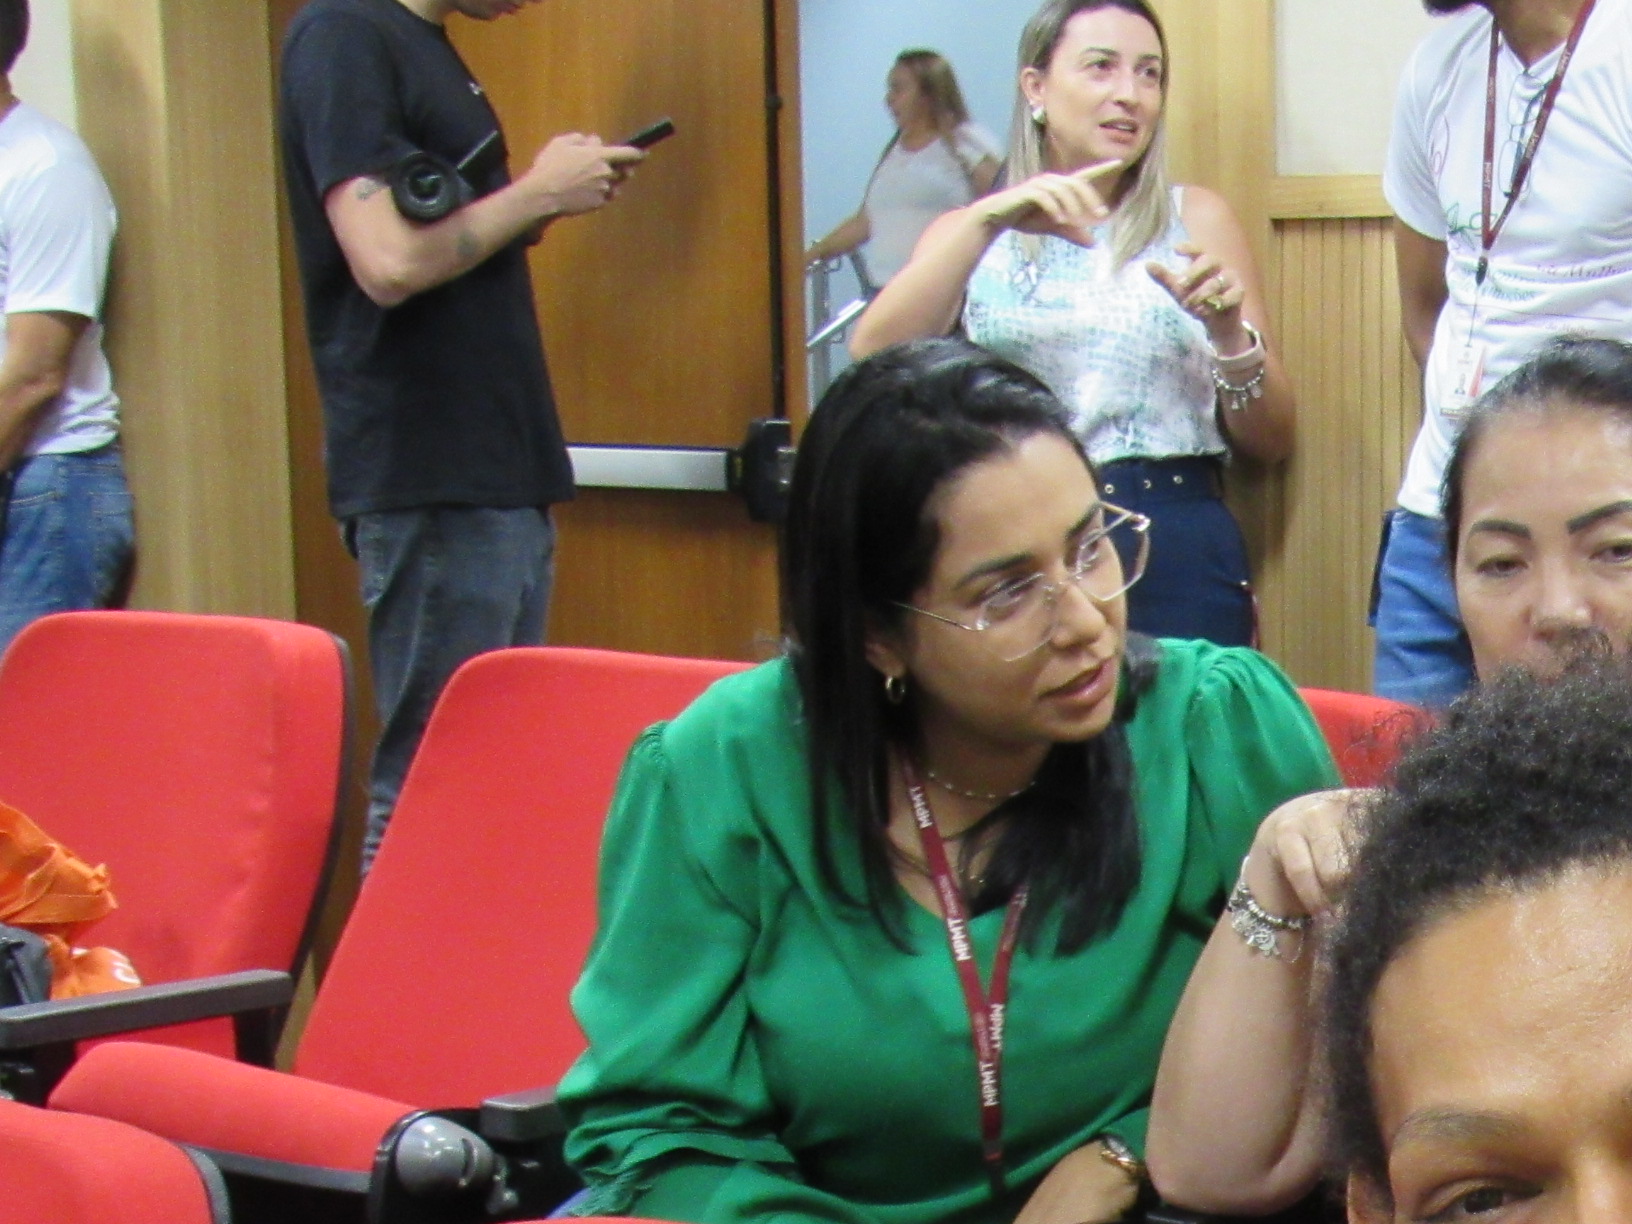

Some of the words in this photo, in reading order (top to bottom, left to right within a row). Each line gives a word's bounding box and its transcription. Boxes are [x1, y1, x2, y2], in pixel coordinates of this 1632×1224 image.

[909, 785, 933, 829] MPMT
[947, 917, 972, 962] MPMT
[988, 1003, 1005, 1052] MPMT
[979, 1061, 1000, 1107] MPMT
